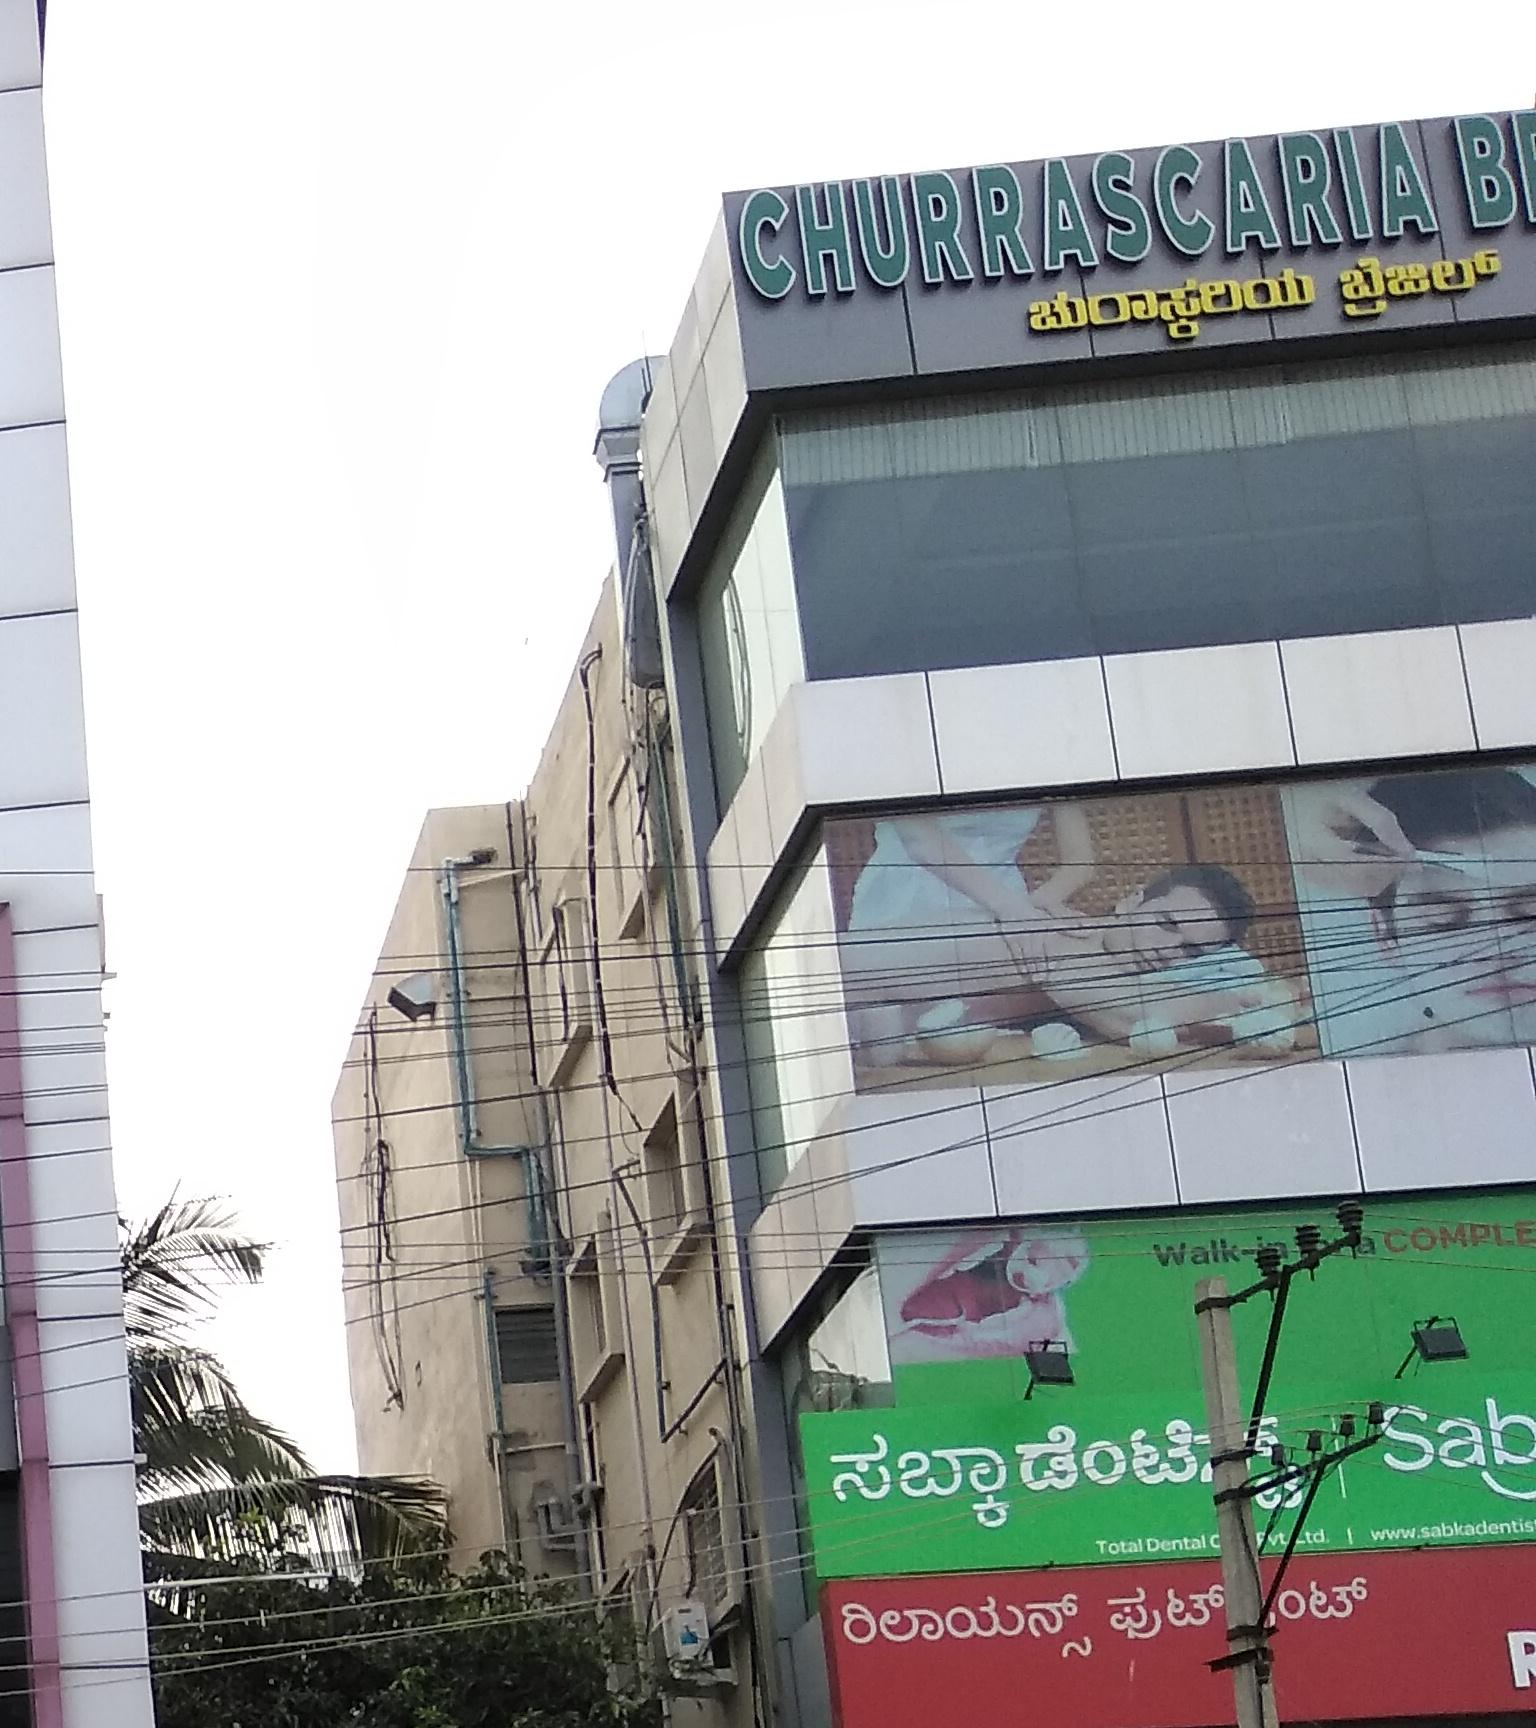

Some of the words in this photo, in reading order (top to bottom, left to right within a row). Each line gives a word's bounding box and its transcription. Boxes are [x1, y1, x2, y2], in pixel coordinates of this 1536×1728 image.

[739, 121, 1439, 299] CHURRASCARIA
[1096, 1539, 1144, 1554] Total
[1147, 1534, 1203, 1551] Dental
